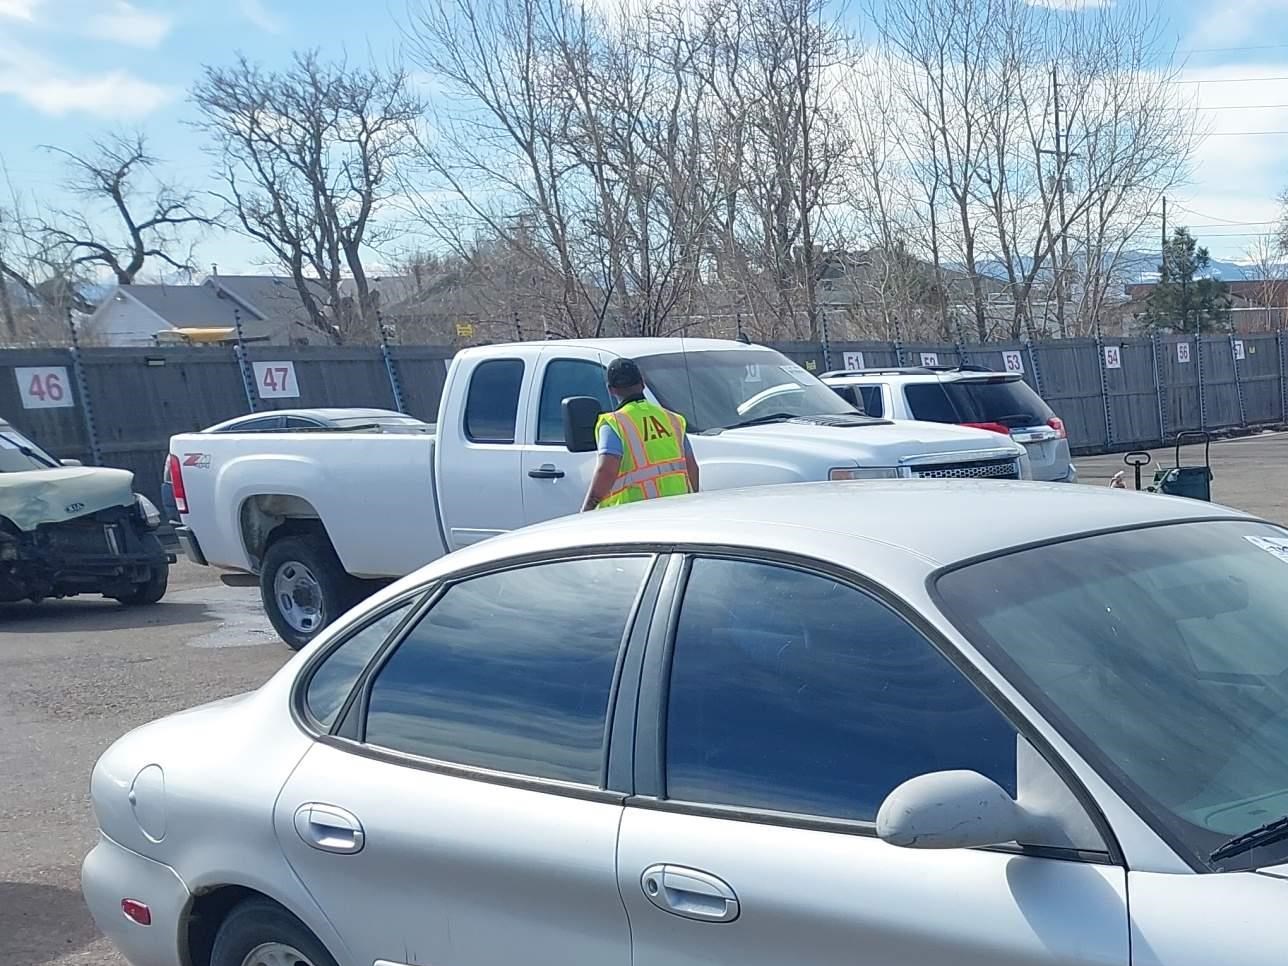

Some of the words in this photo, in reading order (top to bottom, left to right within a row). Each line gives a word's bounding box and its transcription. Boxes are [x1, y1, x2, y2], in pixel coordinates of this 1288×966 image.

[847, 356, 860, 370] 51
[1006, 354, 1020, 370] 53
[1107, 350, 1118, 364] 54
[29, 373, 63, 401] 46
[263, 367, 289, 391] 47
